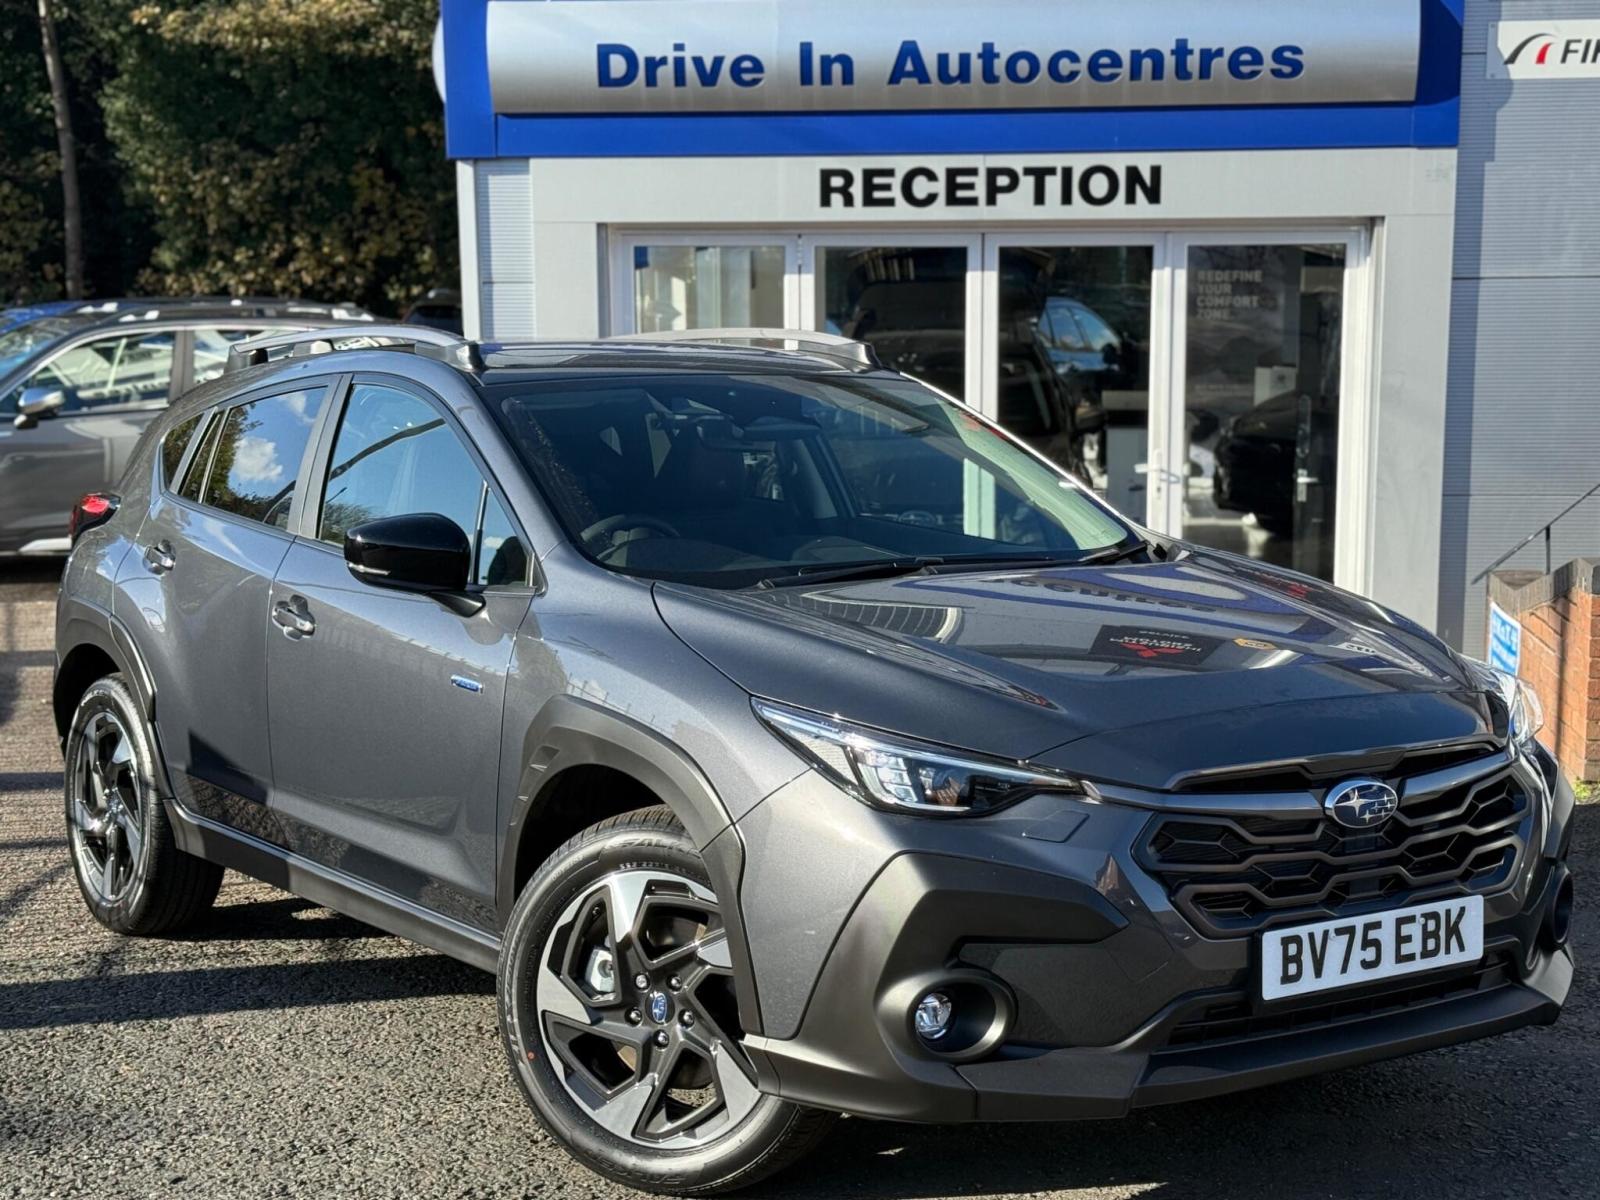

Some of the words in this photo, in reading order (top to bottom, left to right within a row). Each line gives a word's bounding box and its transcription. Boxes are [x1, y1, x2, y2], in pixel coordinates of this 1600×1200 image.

[597, 43, 765, 88] Drive
[800, 42, 855, 86] In
[887, 38, 1305, 85] Autocentres
[819, 164, 1162, 208] RECEPTION
[1197, 269, 1262, 282] REDEFINE
[1198, 283, 1232, 294] YOUR
[1196, 295, 1258, 307] COMFORT
[1280, 920, 1383, 986] BV75
[1395, 905, 1467, 965] EBK
